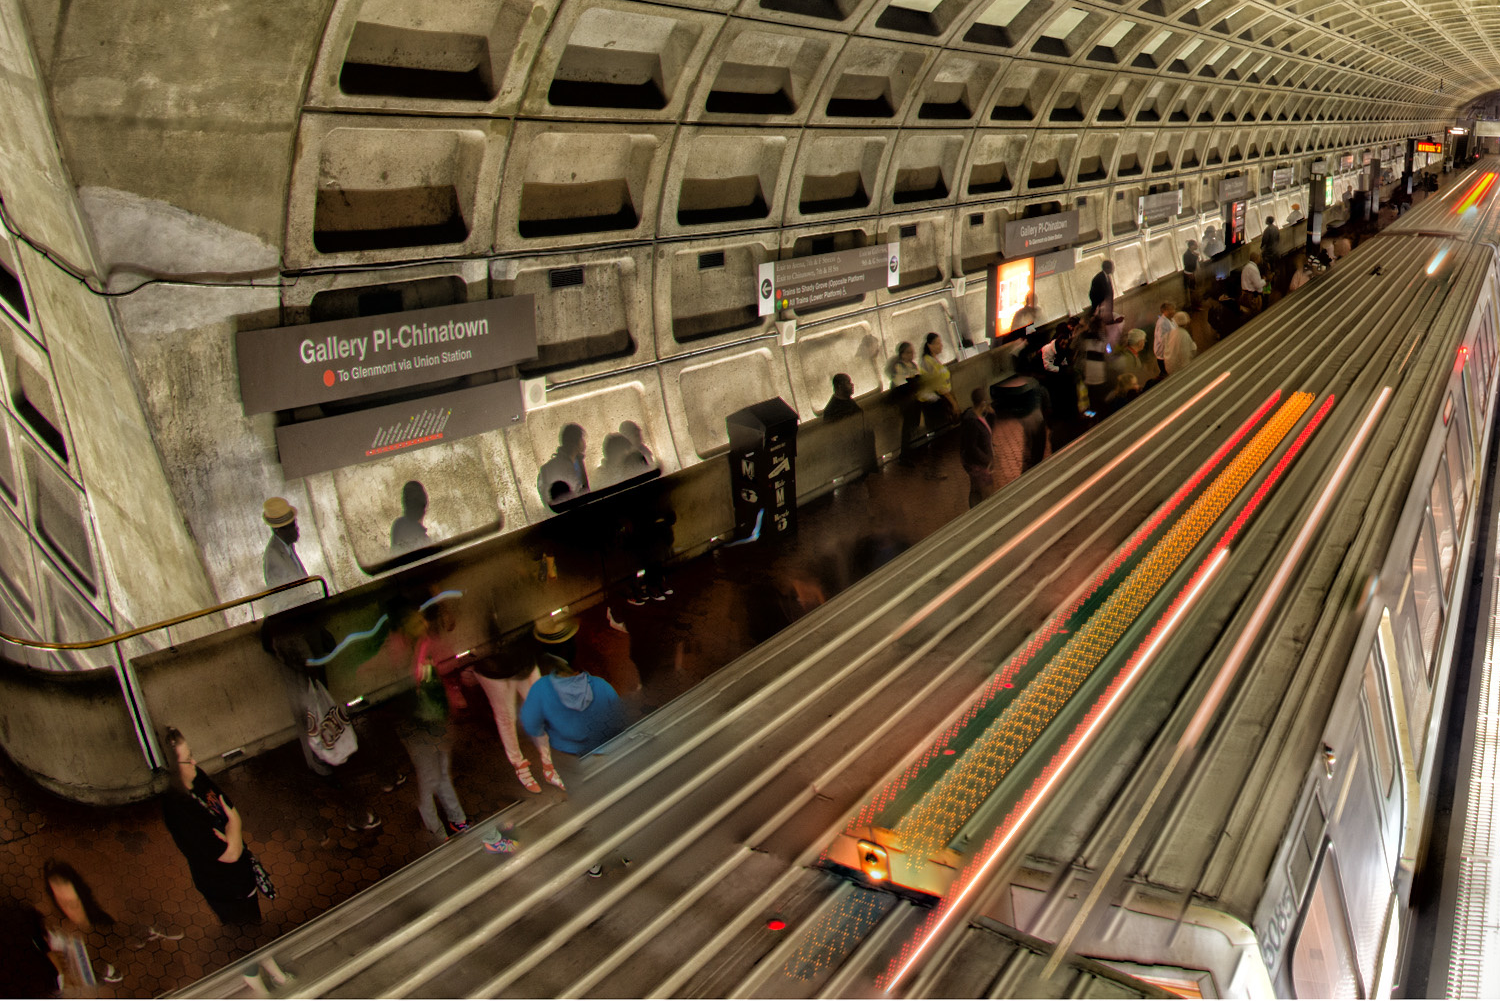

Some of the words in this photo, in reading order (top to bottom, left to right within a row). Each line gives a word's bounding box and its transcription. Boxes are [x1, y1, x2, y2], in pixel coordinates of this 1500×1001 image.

[1021, 225, 1038, 237] Gallery
[782, 287, 795, 296] Trains
[802, 283, 815, 293] Shady
[815, 281, 828, 289] Grove
[828, 277, 847, 289] (Opposite
[847, 273, 865, 284] Platform)
[796, 297, 809, 305] Trains
[809, 293, 823, 303] (Lower
[823, 288, 842, 299] Platform)
[300, 336, 368, 364] Gallery
[372, 319, 489, 352] Pl-Chinatown
[337, 370, 350, 382] To
[351, 361, 398, 379] Glenmont
[398, 358, 412, 371] via
[413, 354, 440, 369] Union
[442, 349, 472, 363] Station
[1262, 886, 1292, 969] 5085
